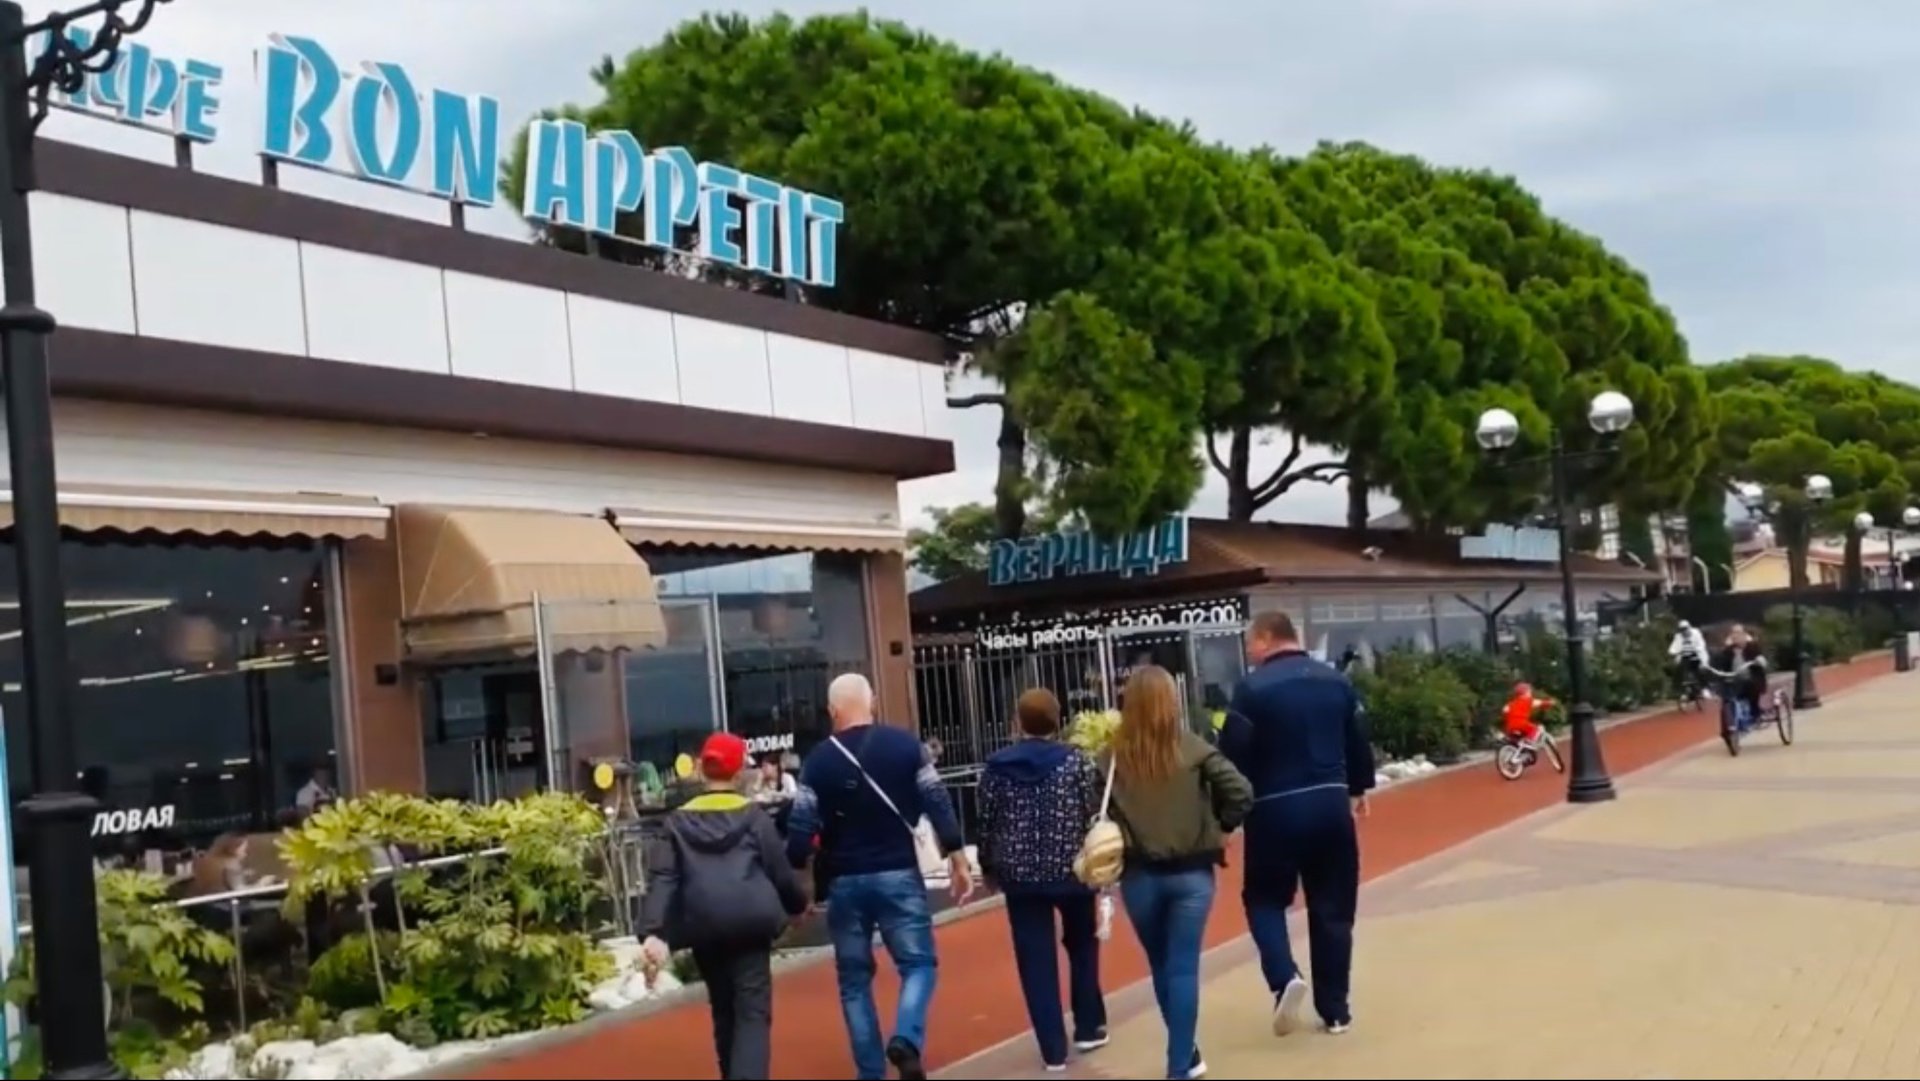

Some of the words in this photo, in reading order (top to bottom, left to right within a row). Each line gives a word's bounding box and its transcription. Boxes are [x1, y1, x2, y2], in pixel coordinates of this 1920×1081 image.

[264, 34, 499, 206] BON
[524, 118, 844, 288] APPETIT
[980, 632, 1028, 650] Часы
